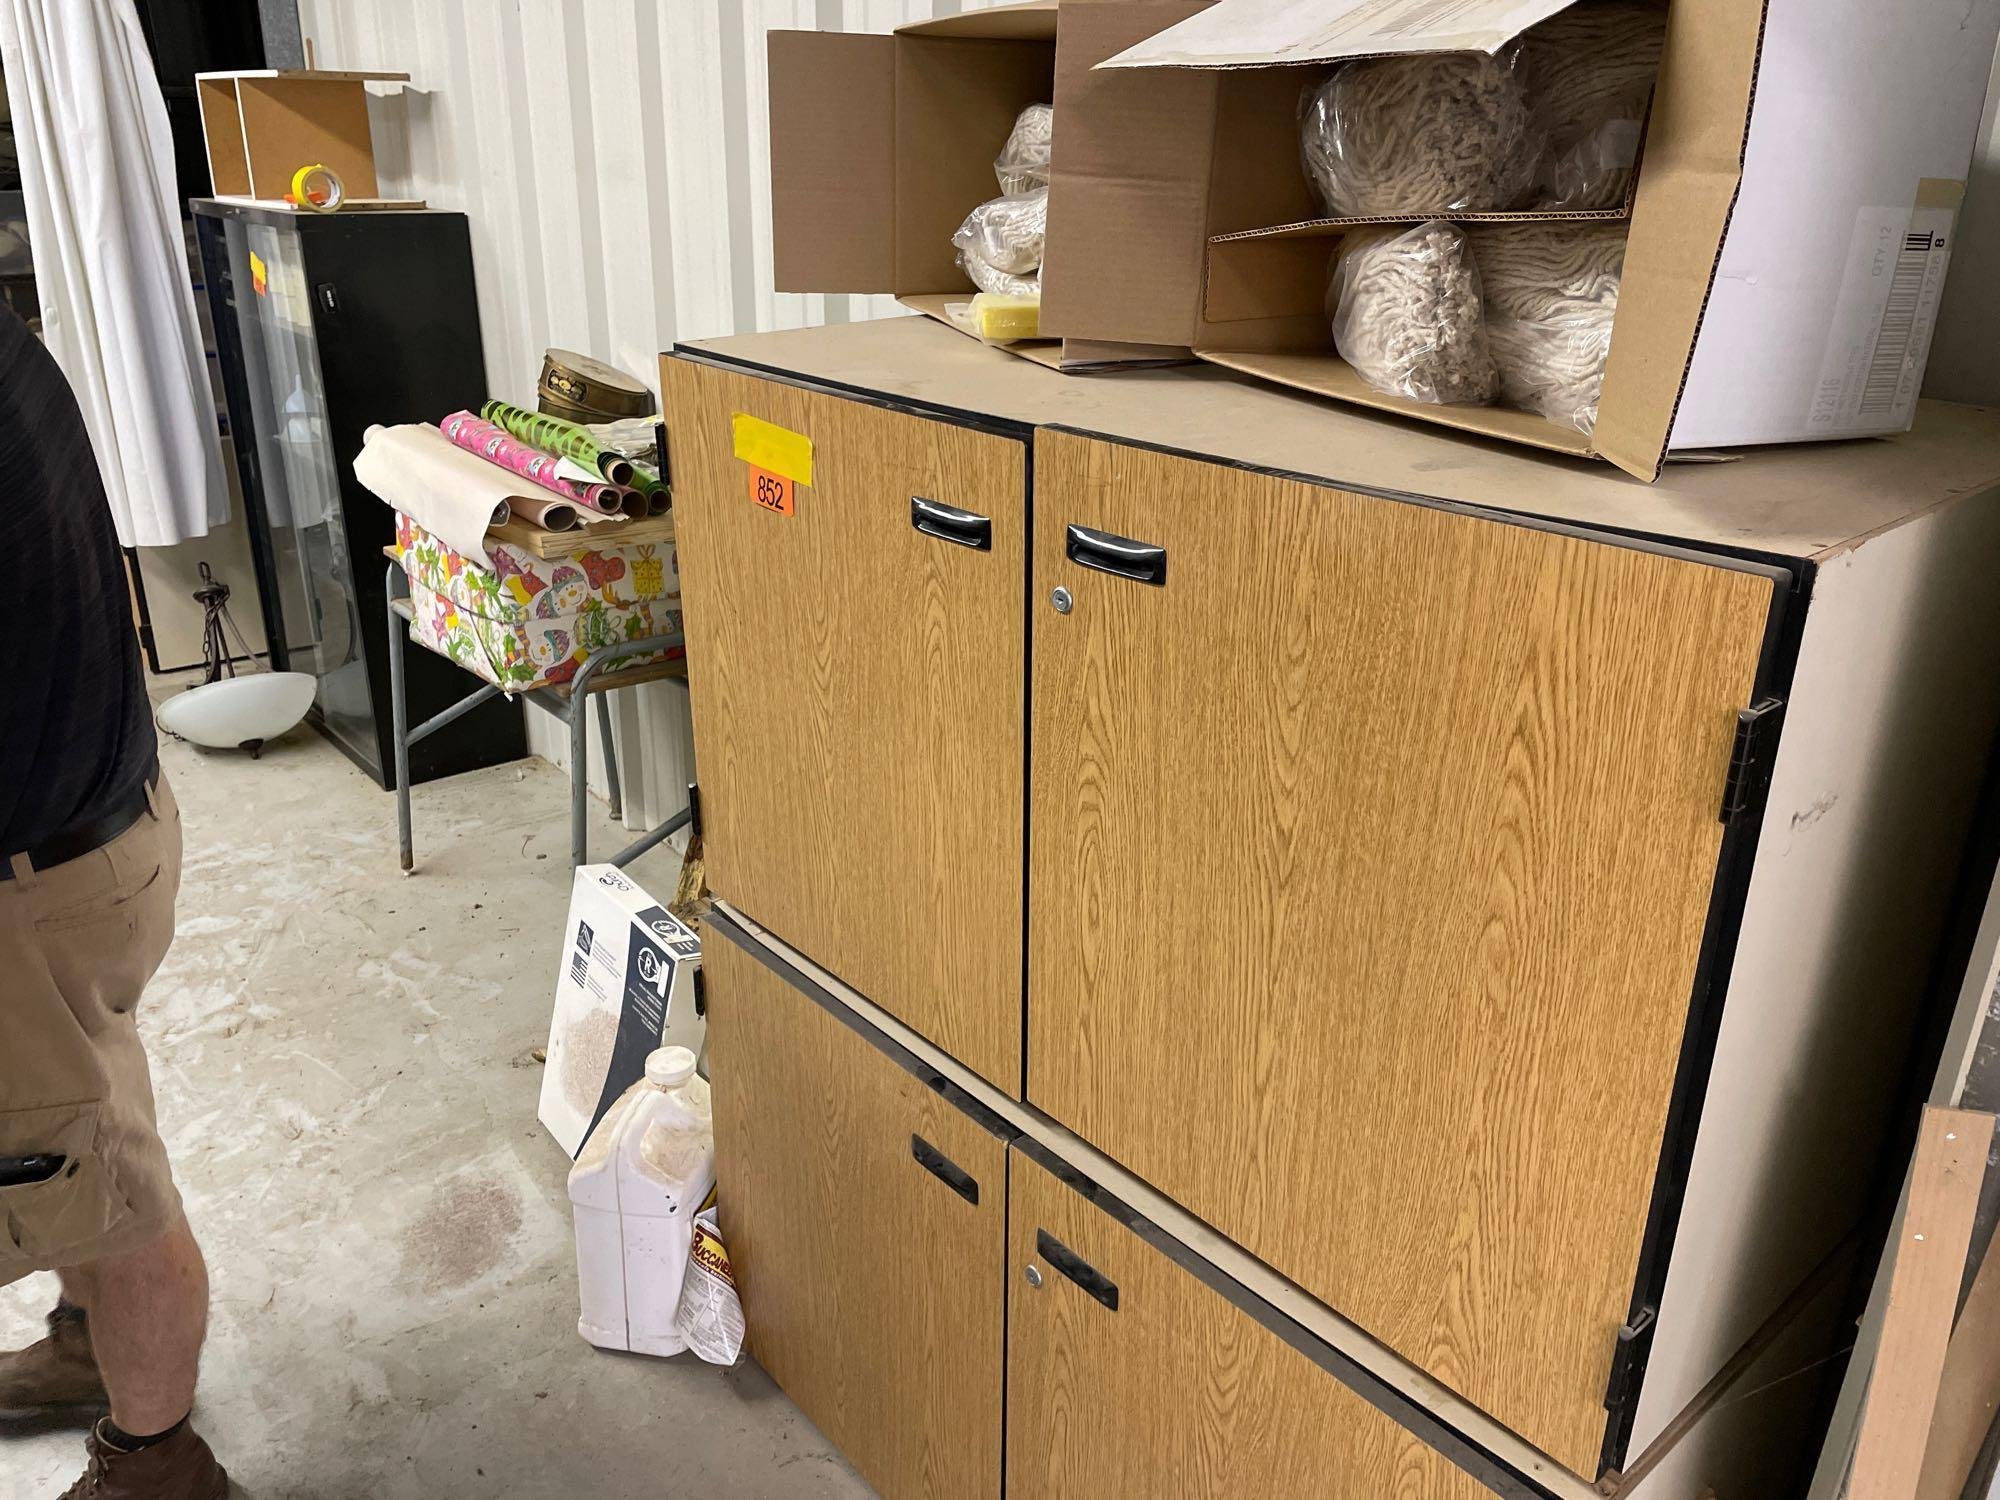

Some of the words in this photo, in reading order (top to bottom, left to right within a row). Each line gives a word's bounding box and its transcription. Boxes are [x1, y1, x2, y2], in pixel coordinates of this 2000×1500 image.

[1934, 238, 1945, 248] 8
[757, 475, 784, 511] 852
[692, 1231, 735, 1281] BUCCANEE
